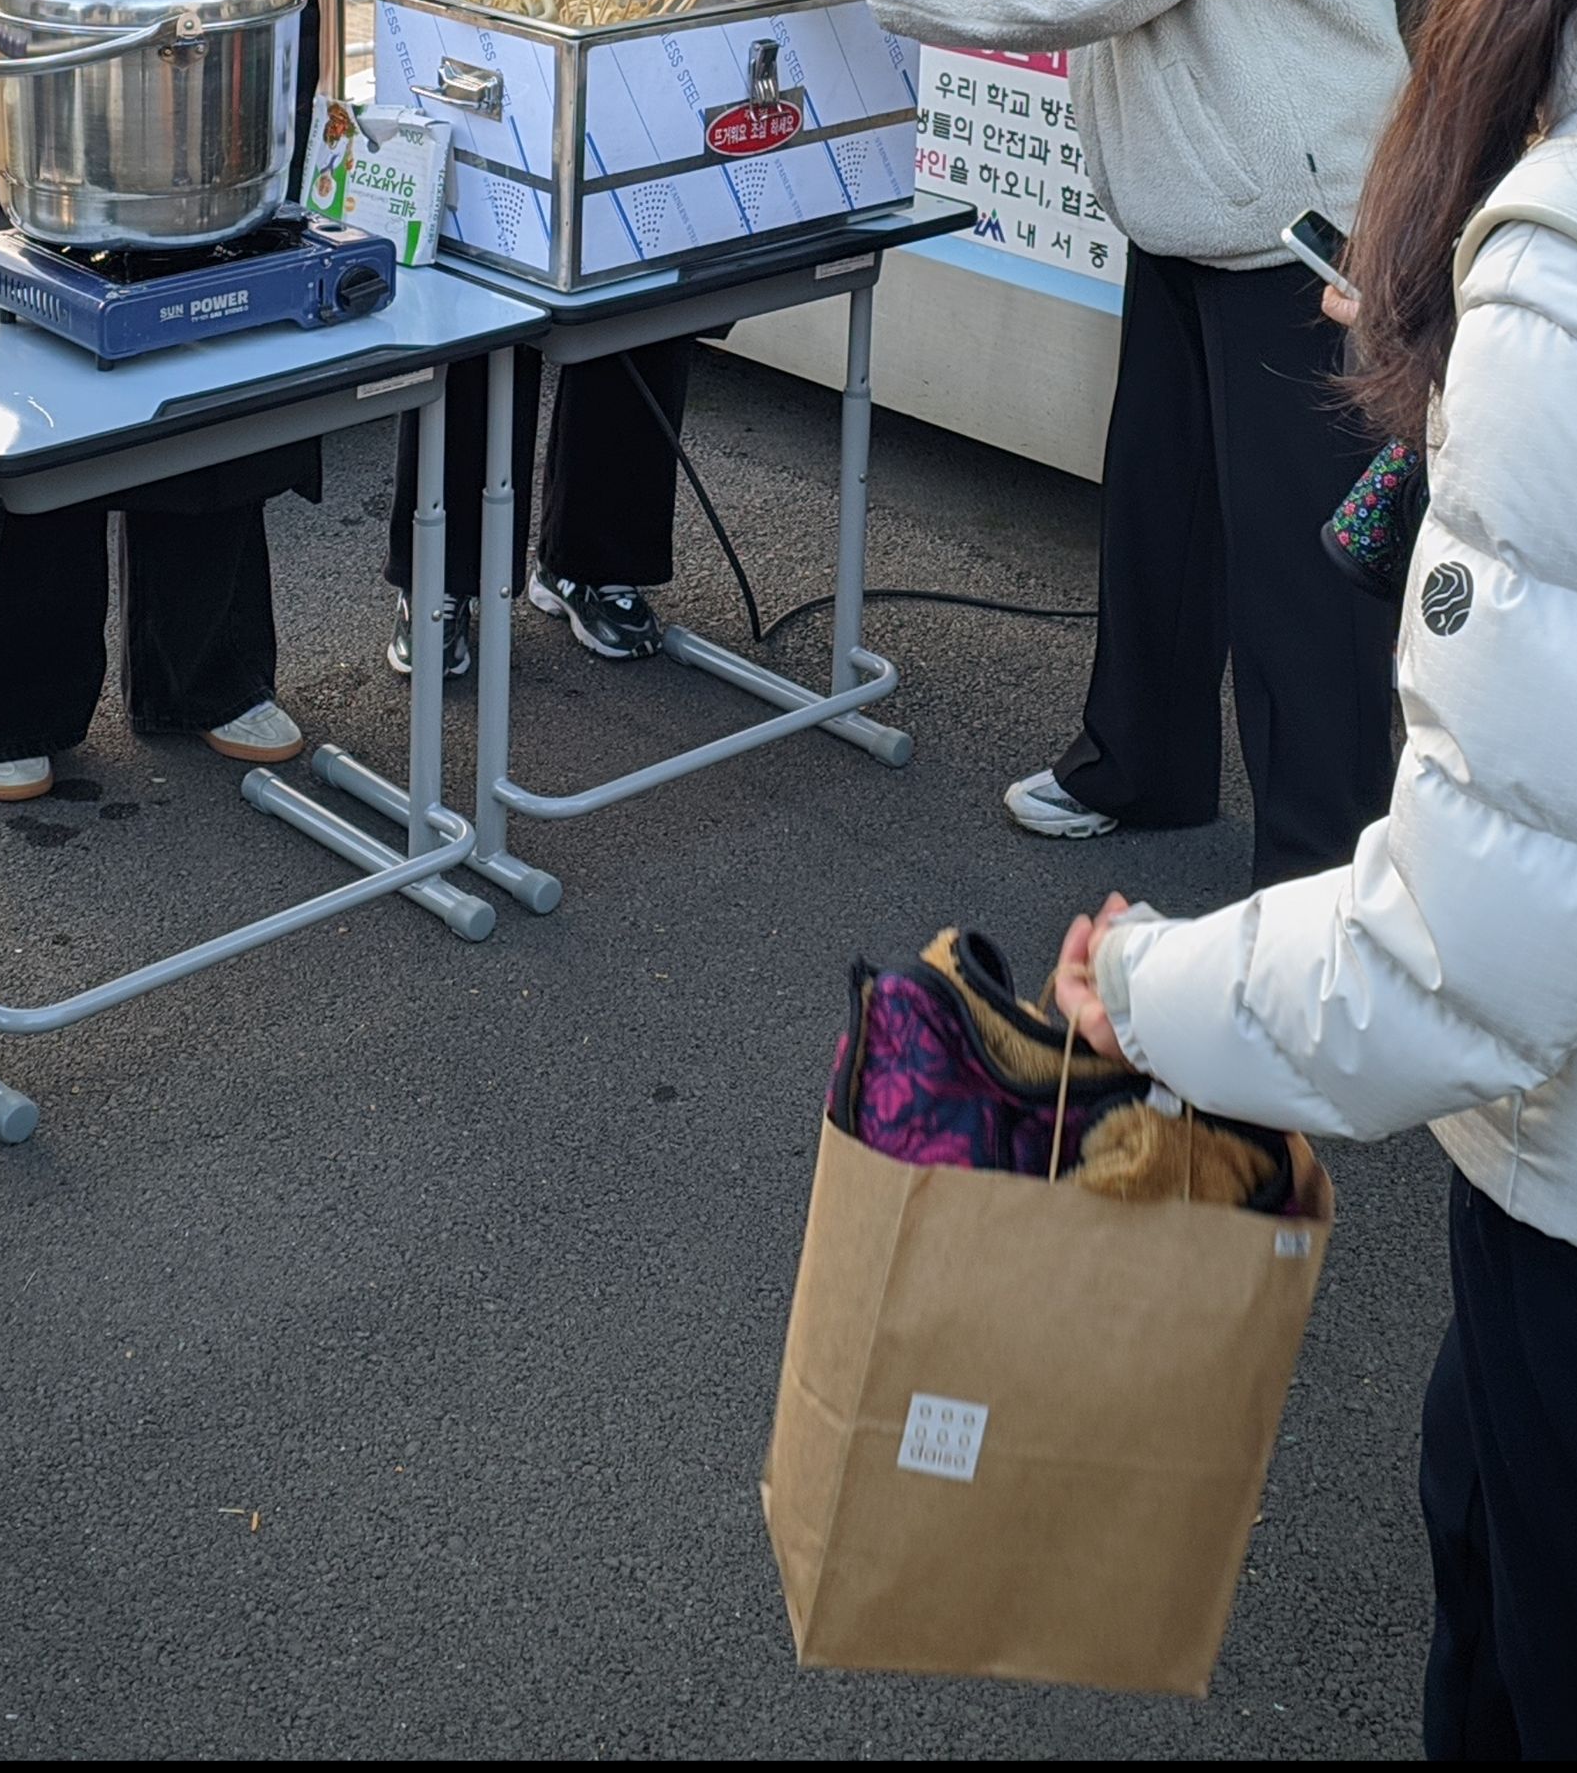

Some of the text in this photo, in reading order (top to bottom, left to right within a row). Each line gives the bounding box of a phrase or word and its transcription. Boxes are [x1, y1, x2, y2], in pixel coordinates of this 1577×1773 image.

[395, 41, 416, 84] STEEL
[784, 50, 805, 87] STEEL
[677, 69, 701, 110] STEEL
[935, 72, 977, 106] 우리
[987, 83, 1030, 118] 학교
[983, 124, 1051, 165] 안전과
[1060, 142, 1090, 177] 학
[350, 159, 417, 198] 위생장갑
[979, 163, 1051, 209] 하오니,
[160, 303, 184, 320] SUN
[190, 290, 249, 316] POWER
